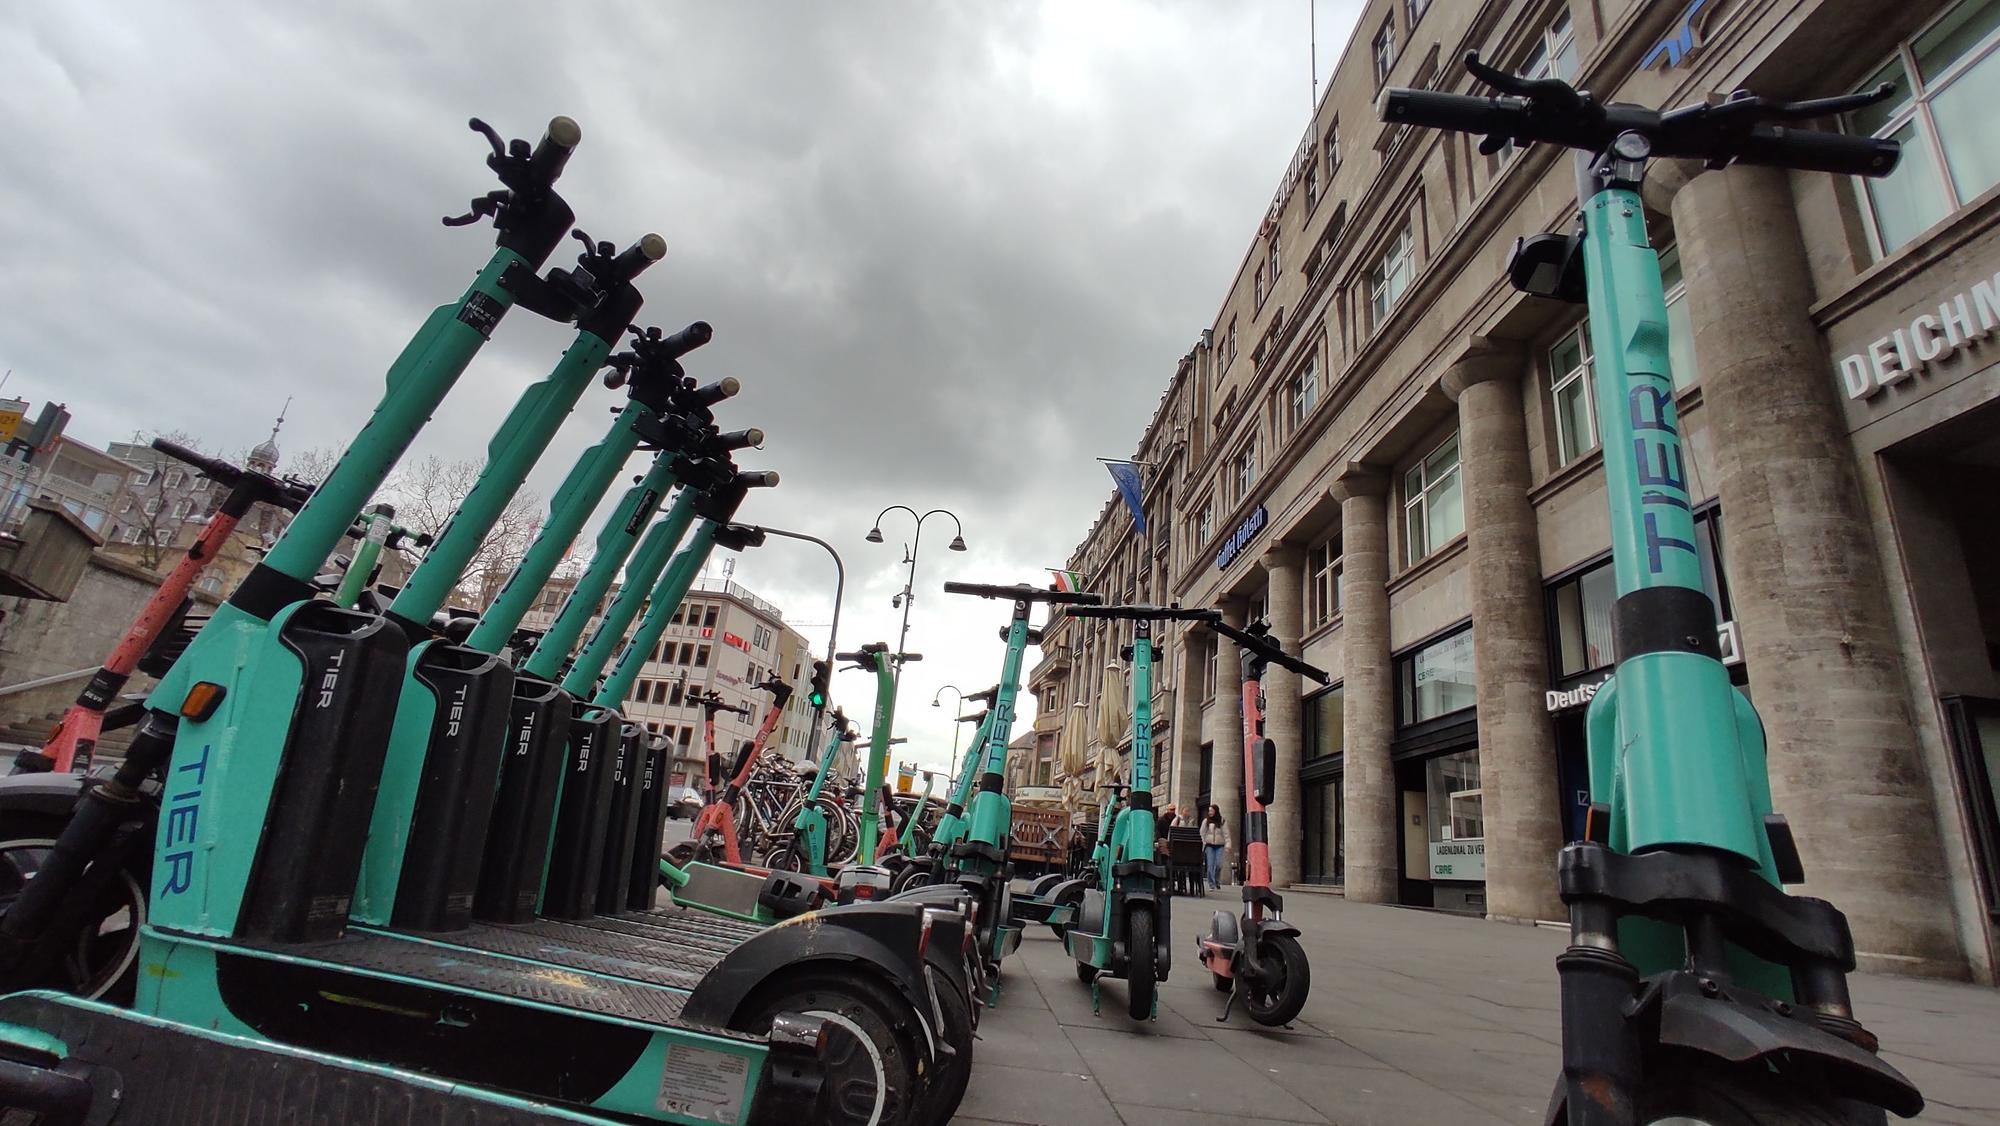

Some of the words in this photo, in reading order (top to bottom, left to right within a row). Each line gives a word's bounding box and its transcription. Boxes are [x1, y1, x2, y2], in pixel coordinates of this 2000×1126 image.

[1629, 384, 1697, 574] TIER
[316, 649, 344, 708] TIER
[1546, 674, 1612, 711] Deuts
[446, 684, 467, 736] TIER
[517, 711, 535, 755] TIER
[577, 732, 593, 772] TIER
[987, 704, 1011, 768] TIER
[1136, 723, 1148, 788] TIER
[643, 757, 654, 790] TIER
[160, 744, 210, 899] TIER
[1434, 864, 1452, 875] CBRE
[1467, 845, 1475, 855] ZU
